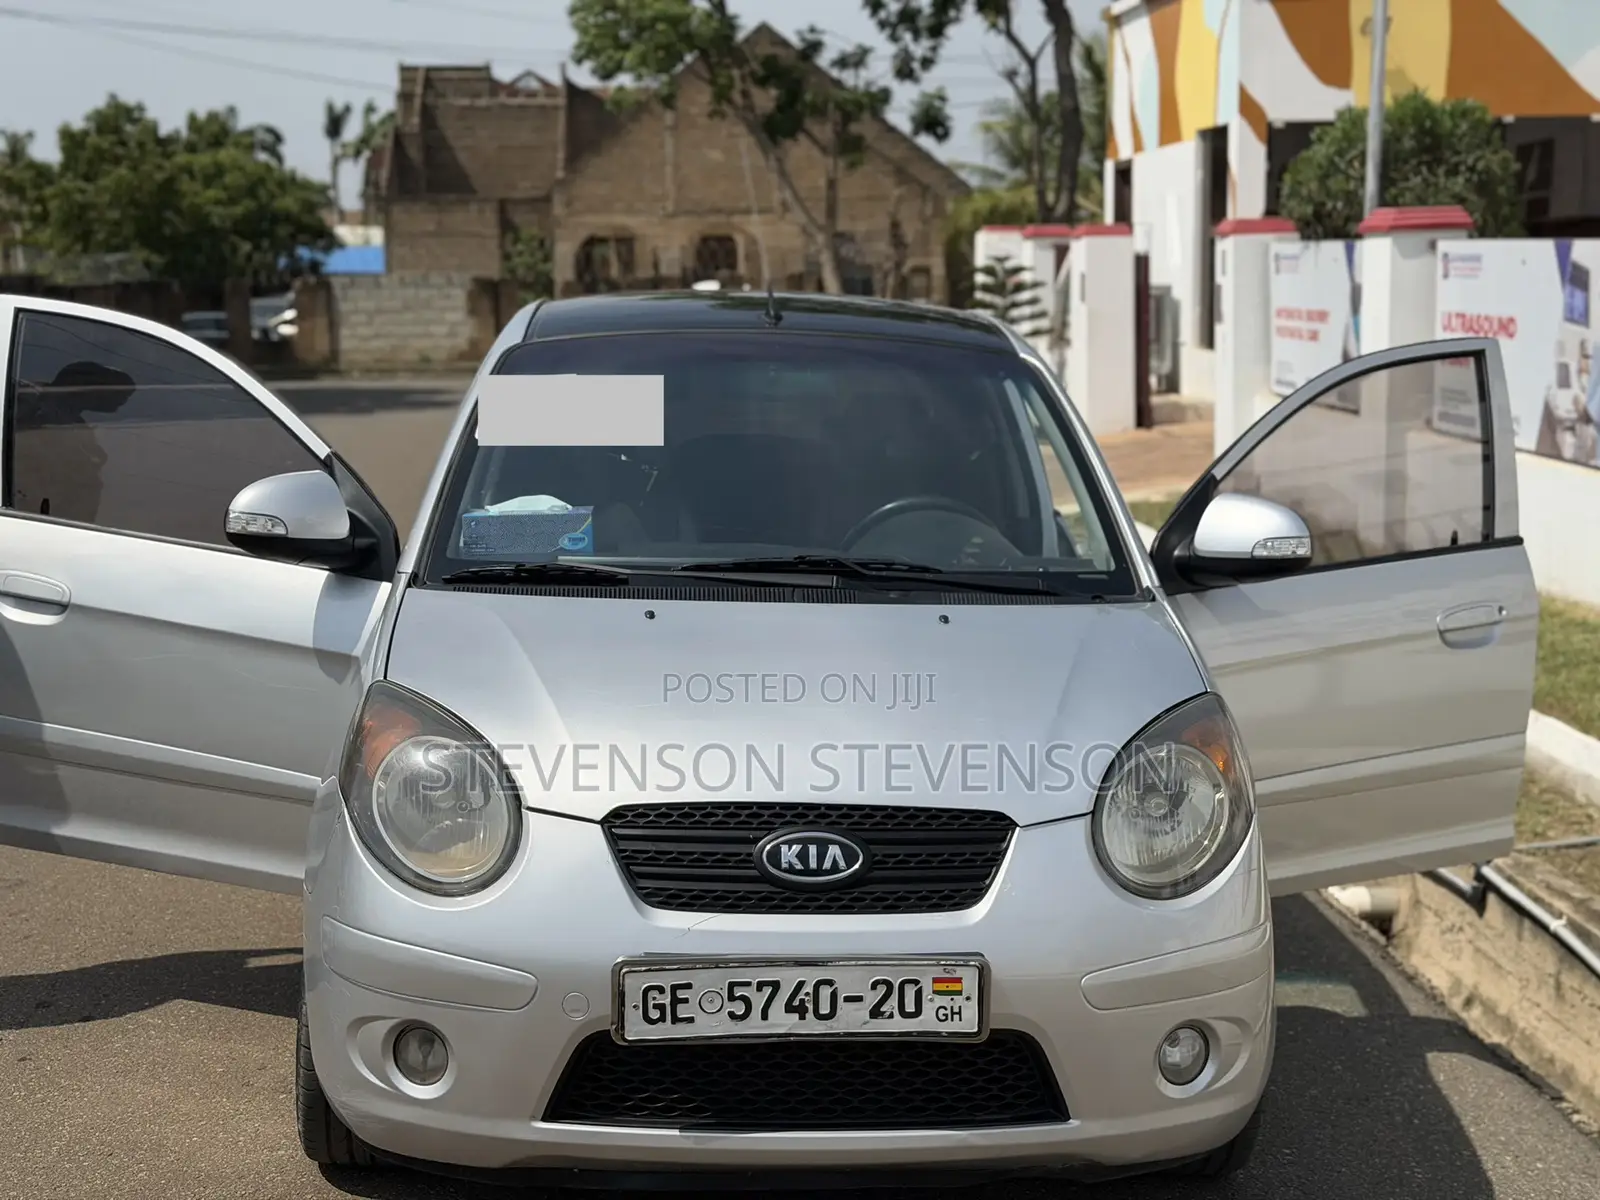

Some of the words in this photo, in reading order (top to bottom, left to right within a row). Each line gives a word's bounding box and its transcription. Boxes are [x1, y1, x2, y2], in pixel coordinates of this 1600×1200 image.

[1441, 311, 1517, 339] ULTRASOUND
[779, 843, 848, 871] KIA
[640, 980, 695, 1026] GE
[726, 976, 924, 1022] 5740-20
[934, 1004, 963, 1023] GH
